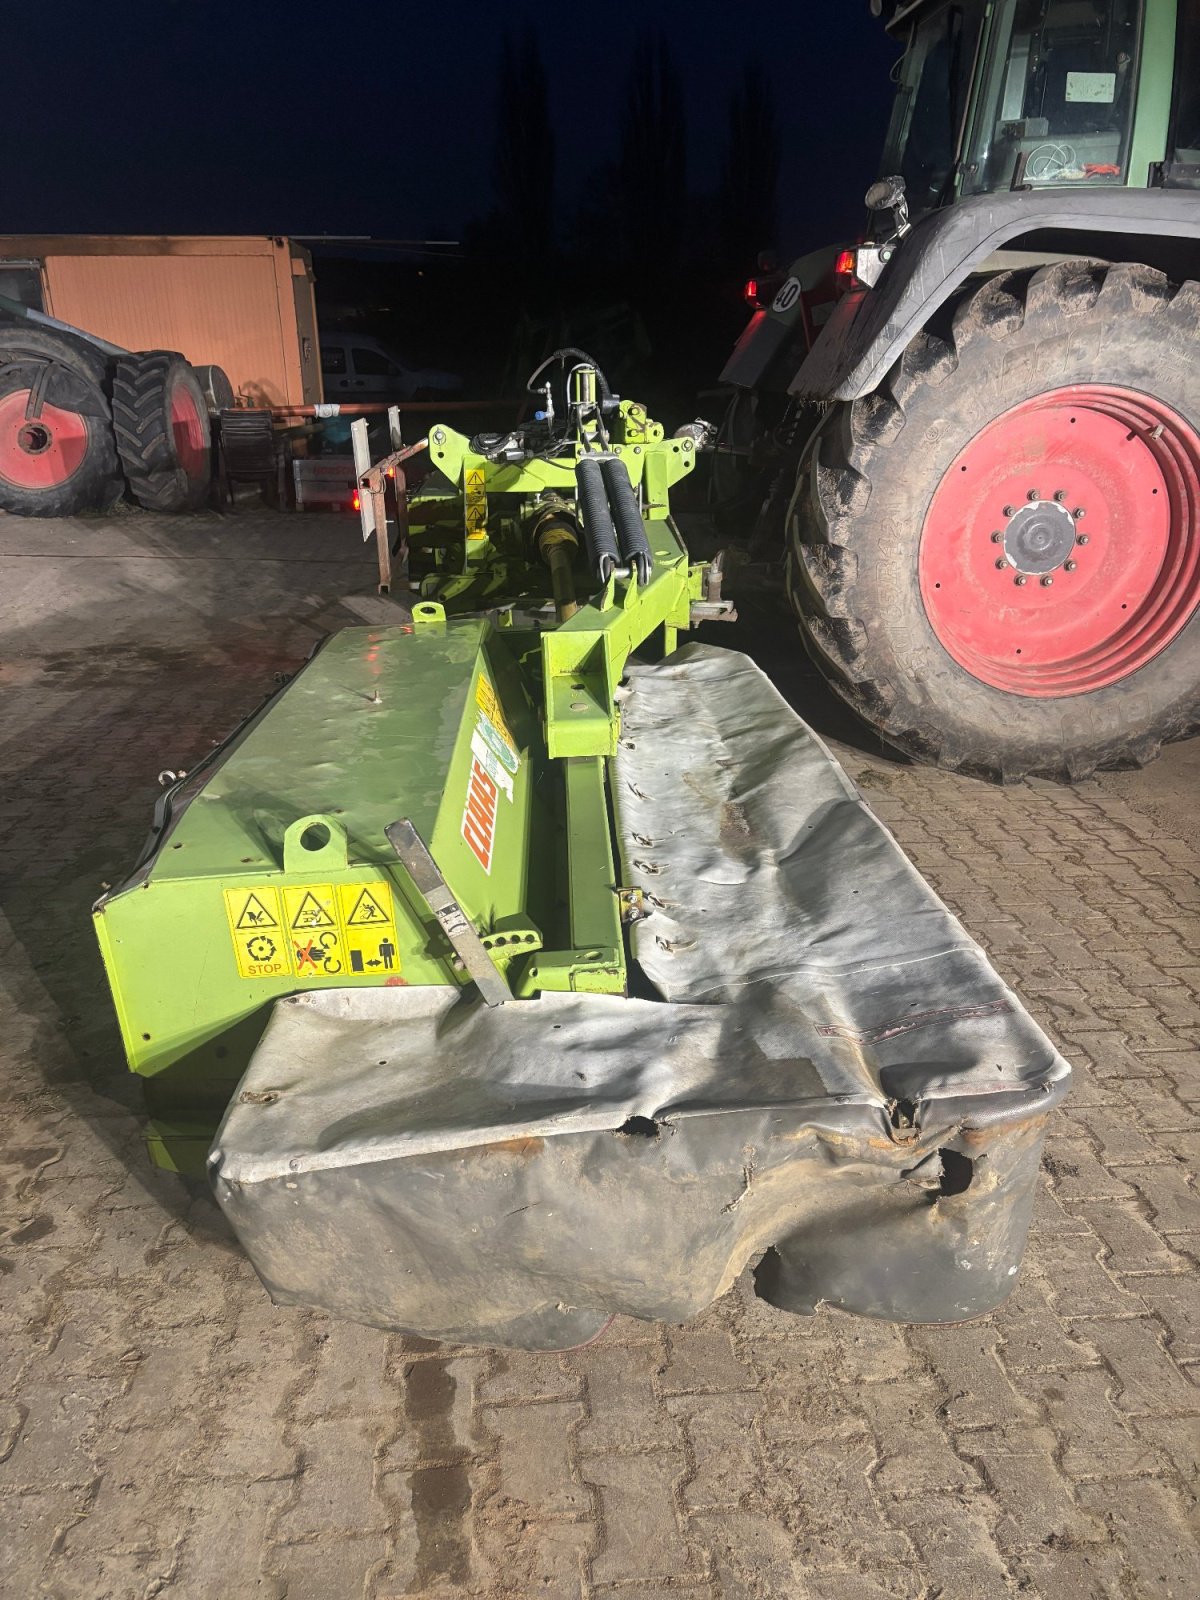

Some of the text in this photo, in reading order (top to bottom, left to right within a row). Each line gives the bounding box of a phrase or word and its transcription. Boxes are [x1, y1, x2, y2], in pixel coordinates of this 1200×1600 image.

[775, 281, 799, 308] 40
[463, 758, 498, 871] CLAAS
[248, 963, 282, 975] STOP
